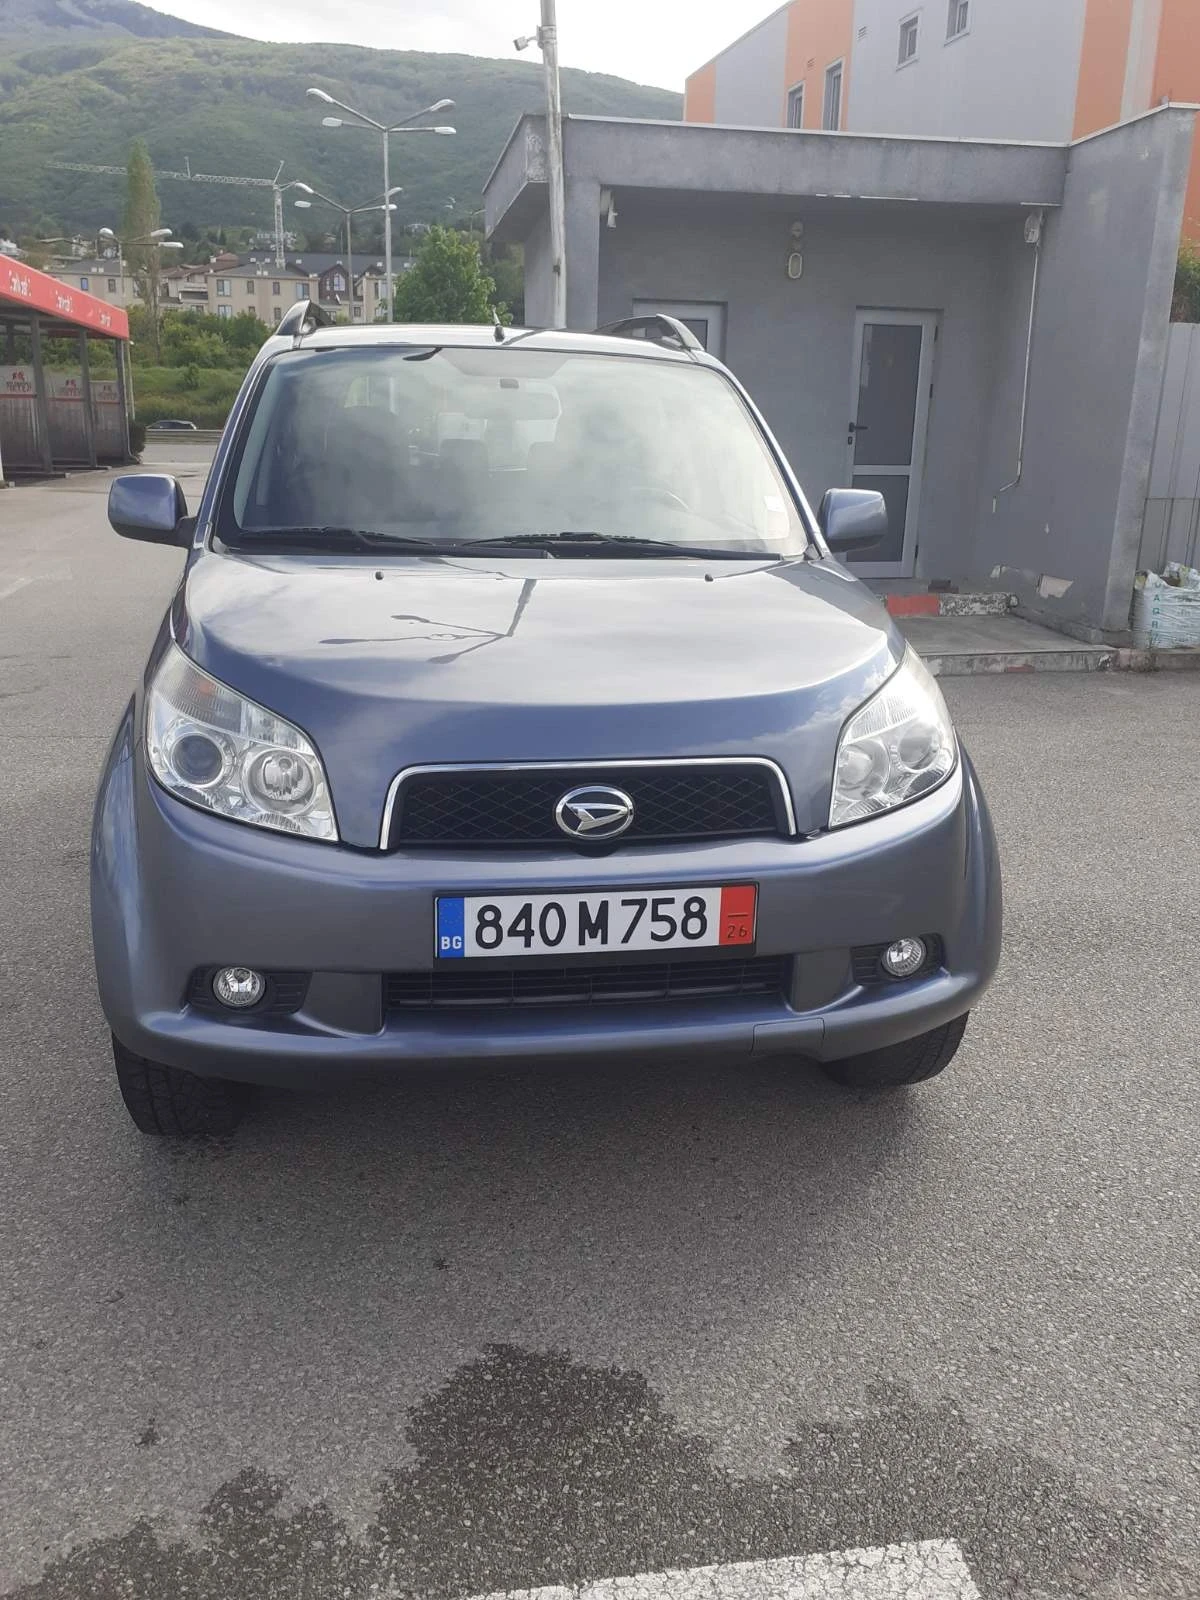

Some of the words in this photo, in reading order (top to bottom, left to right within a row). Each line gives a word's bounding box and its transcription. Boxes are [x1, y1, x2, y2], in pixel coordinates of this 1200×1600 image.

[475, 902, 566, 950] 840
[621, 896, 707, 944] 758
[727, 924, 748, 939] 26
[441, 936, 462, 950] BG
